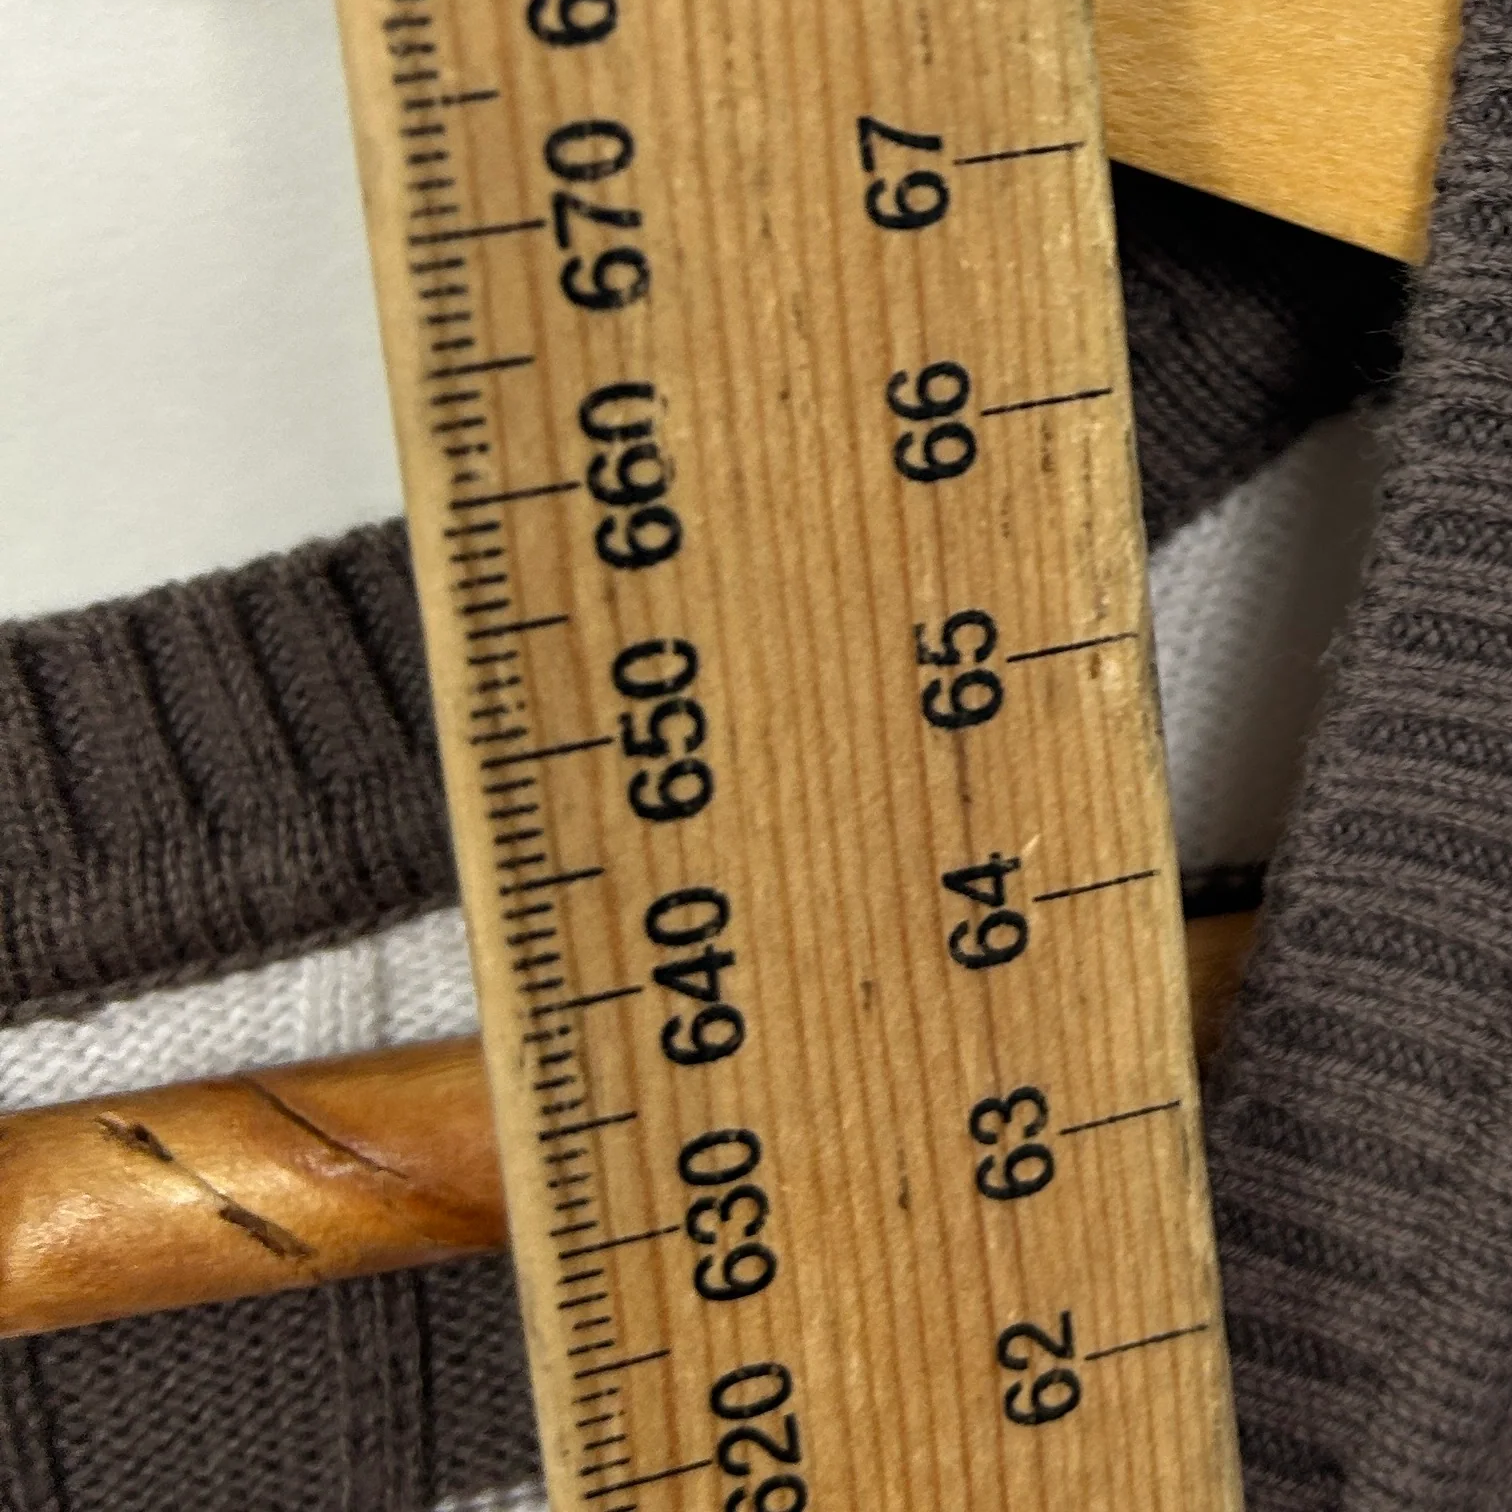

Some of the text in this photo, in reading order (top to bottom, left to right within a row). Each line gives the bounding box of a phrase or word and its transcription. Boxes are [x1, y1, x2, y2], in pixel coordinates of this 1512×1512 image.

[543, 119, 651, 311] 670
[856, 114, 950, 231] 67
[579, 380, 683, 570] 660
[887, 360, 982, 483] 66
[612, 637, 715, 822] 650
[915, 609, 1003, 731] 65
[941, 852, 1029, 970] 64
[643, 887, 746, 1066] 640
[969, 1086, 1055, 1201] 63
[677, 1129, 777, 1301] 630
[996, 1310, 1083, 1426] 62
